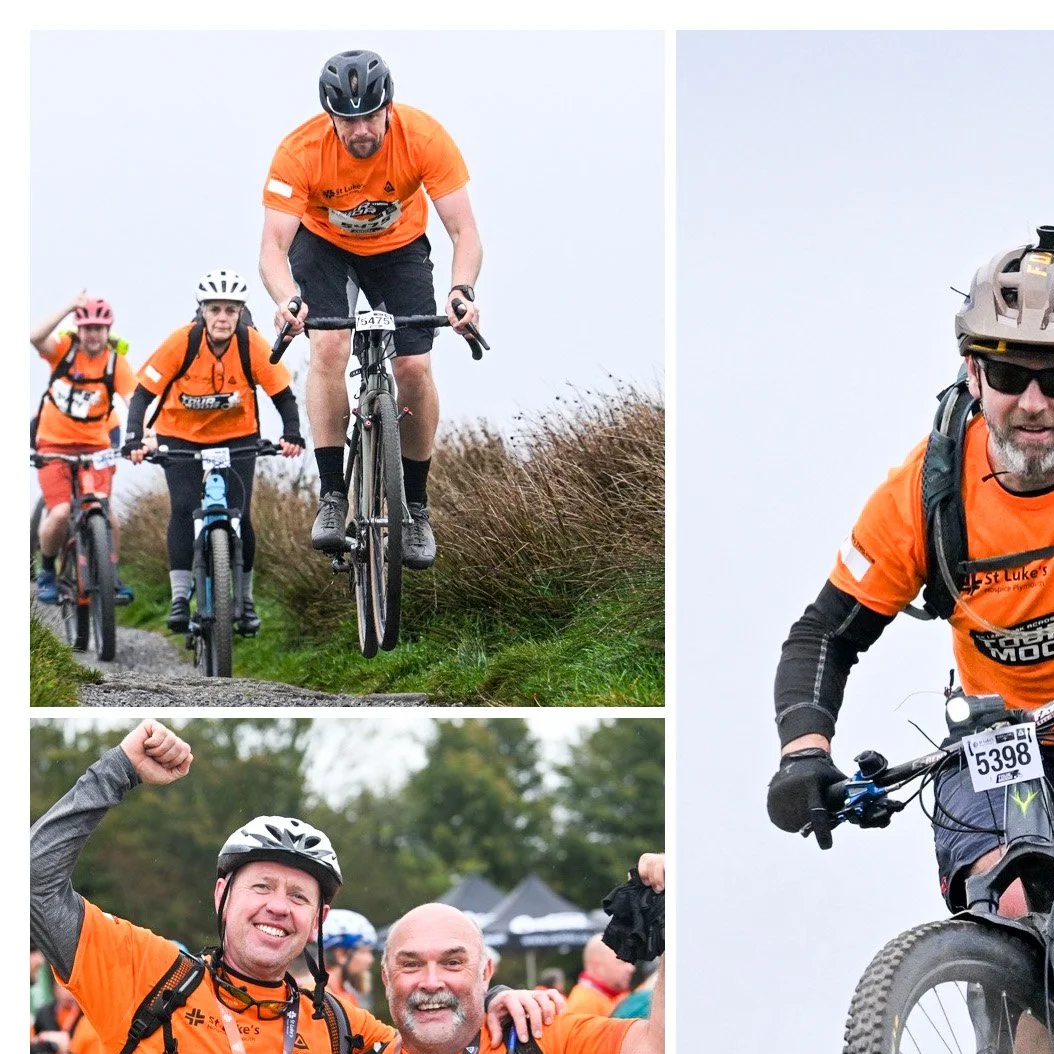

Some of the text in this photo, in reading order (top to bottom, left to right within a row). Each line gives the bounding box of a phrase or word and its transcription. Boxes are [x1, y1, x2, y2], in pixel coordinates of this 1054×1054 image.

[360, 316, 390, 326] 5475
[984, 564, 1048, 585] St Luke's
[975, 741, 1032, 776] 5398
